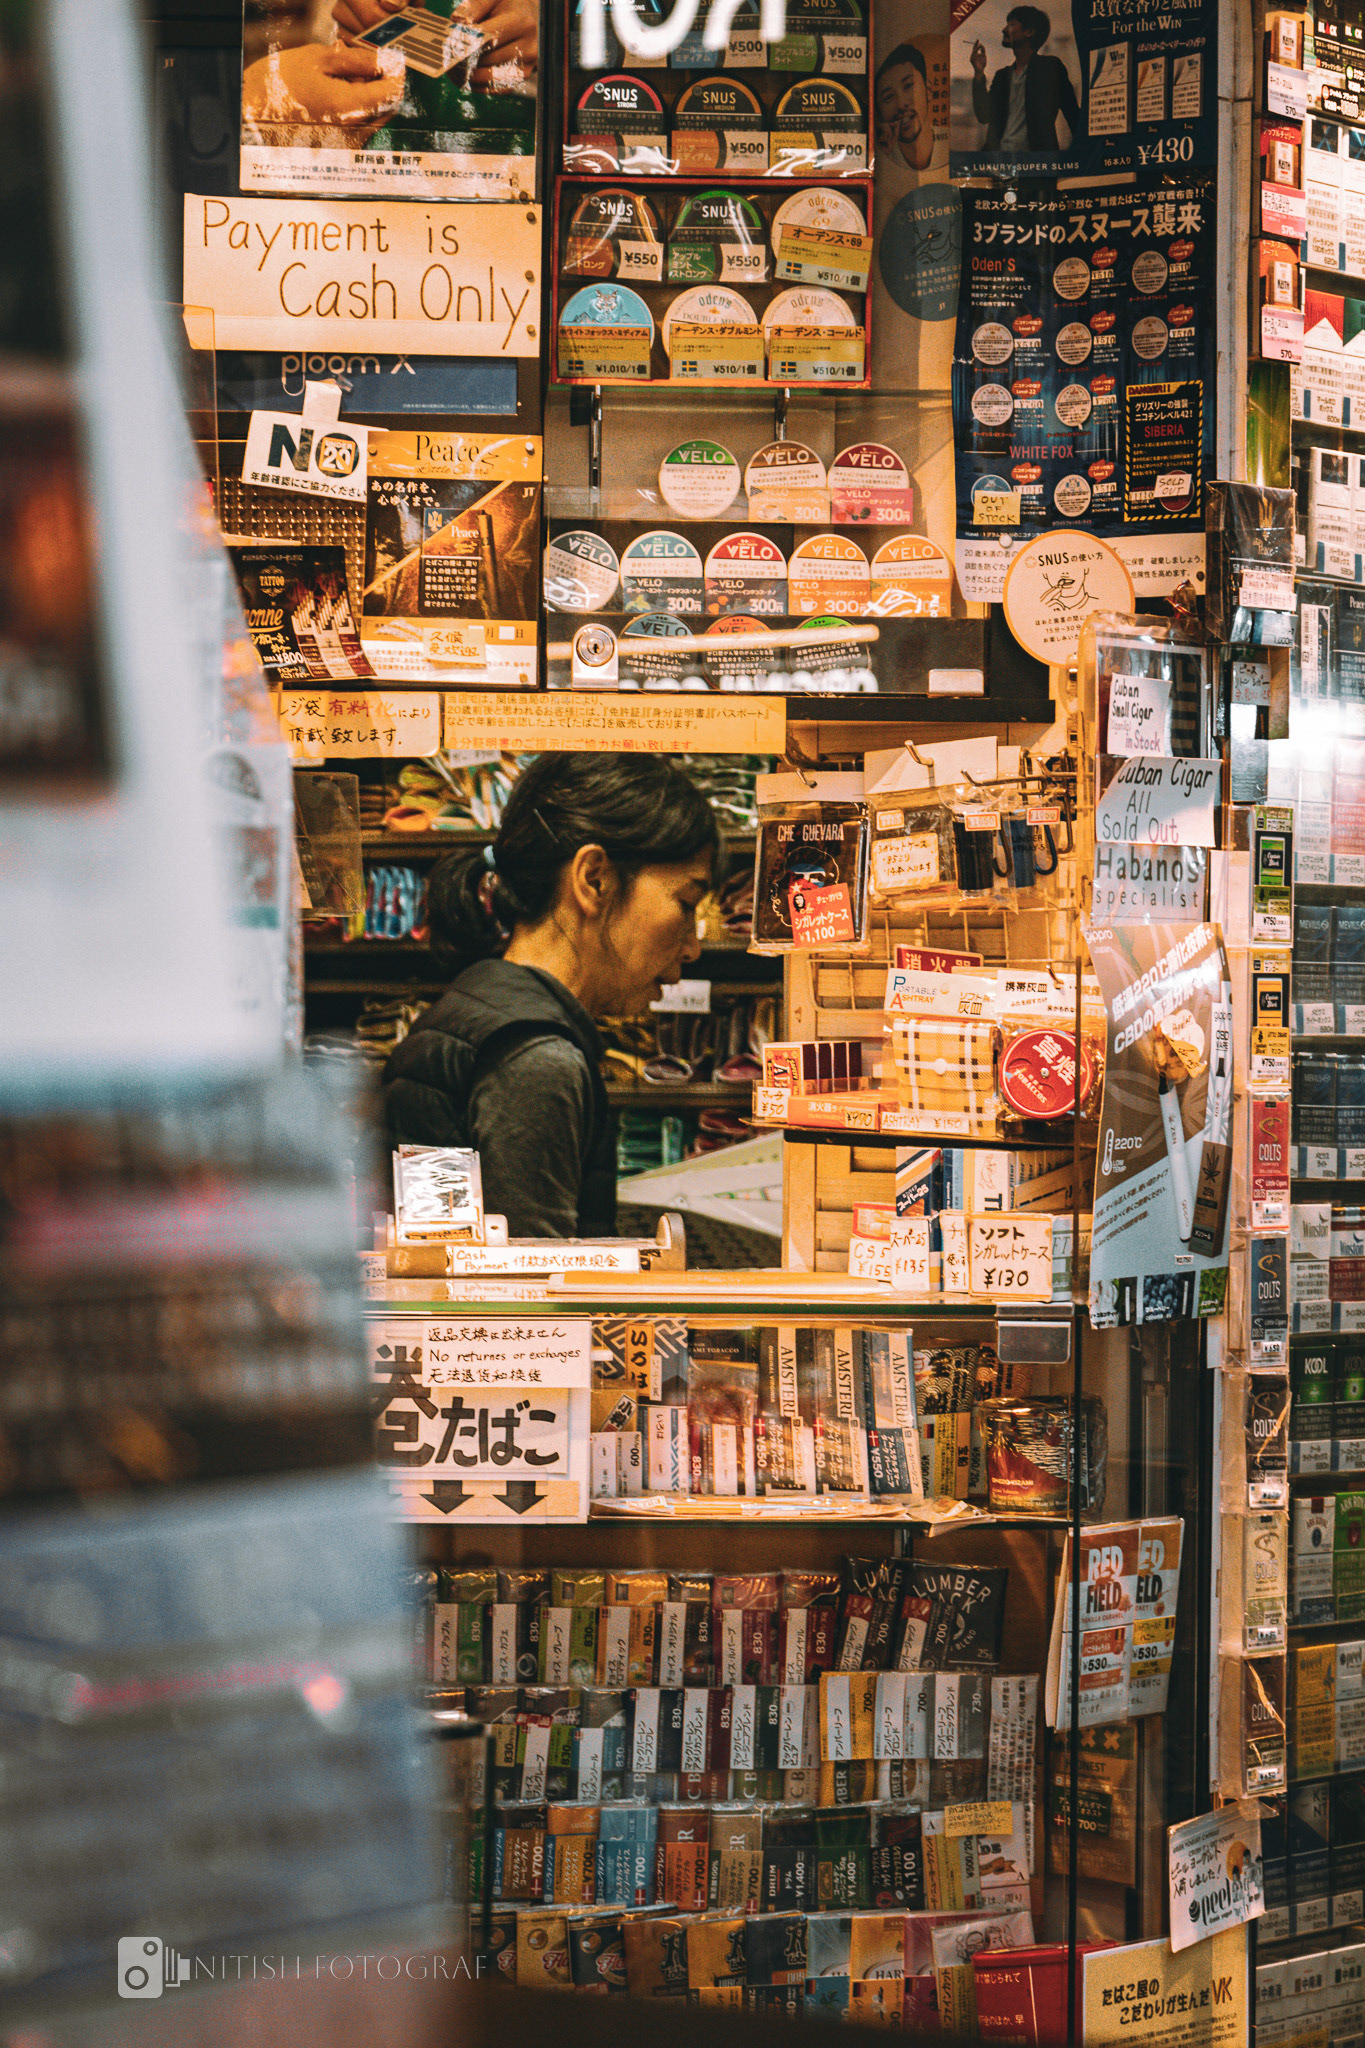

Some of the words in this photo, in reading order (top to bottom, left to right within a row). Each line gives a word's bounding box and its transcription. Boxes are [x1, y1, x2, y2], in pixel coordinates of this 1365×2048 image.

[1112, 20, 1134, 34] For
[1136, 17, 1155, 32] the
[729, 41, 763, 53] ¥500
[828, 46, 862, 59] ¥500
[603, 88, 638, 101] SNUS
[702, 91, 736, 104] SNUS
[802, 92, 836, 105] SNUS
[730, 143, 764, 155] ¥500
[1103, 157, 1131, 167] 16本入り
[1137, 136, 1194, 166] ¥430
[973, 162, 1013, 172] LUXURY
[1016, 162, 1048, 171] SUPER
[1051, 161, 1079, 171] SLIMS
[599, 202, 633, 216] SNUS
[203, 200, 390, 272] Payment
[424, 214, 460, 255] is
[792, 228, 863, 248] オーデンス・69
[1281, 224, 1295, 236] 570
[625, 252, 658, 265] ¥550
[727, 256, 760, 267] ¥550
[817, 270, 861, 287] ¥510/1個
[279, 262, 397, 320] Cash
[420, 263, 530, 350] Only
[674, 326, 763, 336] オーデンス・ダブルミント
[774, 326, 863, 337] オーデンス・コールド
[1280, 349, 1293, 359] 570
[596, 363, 647, 375] ¥1,010/1個
[713, 364, 757, 375] ¥510/1個
[812, 365, 857, 376] ¥510/1個
[1144, 424, 1185, 438] SIBERIA
[416, 435, 480, 461] Peace
[1009, 445, 1049, 459] WHITE
[1051, 445, 1074, 458] FOX
[678, 450, 726, 464] VELO
[763, 449, 810, 465] VELO
[848, 452, 895, 468] VELO
[371, 480, 437, 494] あの名作を、
[1158, 477, 1185, 488] SOLD
[522, 487, 536, 499] JT
[1161, 486, 1184, 496] OUT
[377, 494, 441, 508] 心ゆくまで。
[981, 495, 1009, 505] OUT
[876, 507, 911, 521] 300円
[978, 513, 1017, 524] STOCK
[451, 525, 479, 539] Peace
[567, 537, 612, 566] VELO
[640, 543, 687, 557] VELO
[726, 545, 773, 560] VELO
[259, 575, 285, 588] TATTOO
[667, 597, 702, 612] 300円
[1114, 679, 1140, 699] Cuban
[1112, 700, 1130, 719] Small
[1131, 703, 1154, 726] Cigar
[1126, 732, 1133, 749] in
[1133, 734, 1161, 752] Stock
[1170, 758, 1214, 798] Cigar
[1127, 790, 1151, 813] All
[778, 824, 795, 842] CHE
[802, 823, 845, 842] GUEVARA
[1102, 814, 1138, 842] Sold
[1150, 818, 1178, 844] Out
[1097, 846, 1200, 884] Habanos
[816, 891, 843, 904] チェ・ゲバラ
[1096, 886, 1199, 908] specialist
[794, 908, 849, 930] シガレットケース
[798, 925, 836, 944] ¥1,100
[1005, 981, 1048, 993] 携帯灰皿
[889, 993, 935, 1010] ASHTRAY
[957, 1001, 983, 1015] 灰皿
[1013, 1067, 1048, 1104] TOBACCOS
[761, 1101, 785, 1116] ¥50
[846, 1112, 873, 1127] ¥970
[934, 1117, 962, 1130] ¥150
[1258, 1143, 1282, 1162] COLTS
[979, 1226, 1025, 1241] ソフト
[1302, 1220, 1329, 1238] Winston
[456, 1249, 487, 1261] Cash
[974, 1243, 1052, 1262] シガレットケース
[1339, 1240, 1364, 1256] Winston
[464, 1261, 509, 1273] Payment
[895, 1257, 926, 1275] ¥135
[983, 1267, 1030, 1289] ¥130
[1258, 1281, 1281, 1299] COLTS
[429, 1348, 450, 1363] No
[513, 1351, 526, 1361] or
[529, 1346, 582, 1364] exchanges
[1304, 1357, 1328, 1375] KOOL
[1253, 1417, 1279, 1438] COLTS
[1087, 1545, 1124, 1583] RED
[1255, 1560, 1279, 1581] COLTS
[912, 1574, 992, 1603] LUMBER
[1086, 1580, 1122, 1614] FIELD
[529, 1622, 539, 1642] 830
[584, 1627, 594, 1647] 830
[955, 1628, 977, 1651] BLEND
[1132, 1646, 1158, 1660] ¥530
[1083, 1657, 1108, 1672] ¥530
[863, 1692, 873, 1714] 700
[917, 1692, 927, 1714] 700
[972, 1693, 982, 1714] 730
[532, 1846, 544, 1878] ¥700
[583, 1851, 593, 1883] ¥700
[768, 1864, 777, 1897] DRUM
[795, 1862, 805, 1898] ¥1,400
[1101, 1978, 1160, 2007] たばこ屋の
[1119, 1987, 1210, 2026] こだわりが生んだ
[1211, 1976, 1232, 2005] VK
